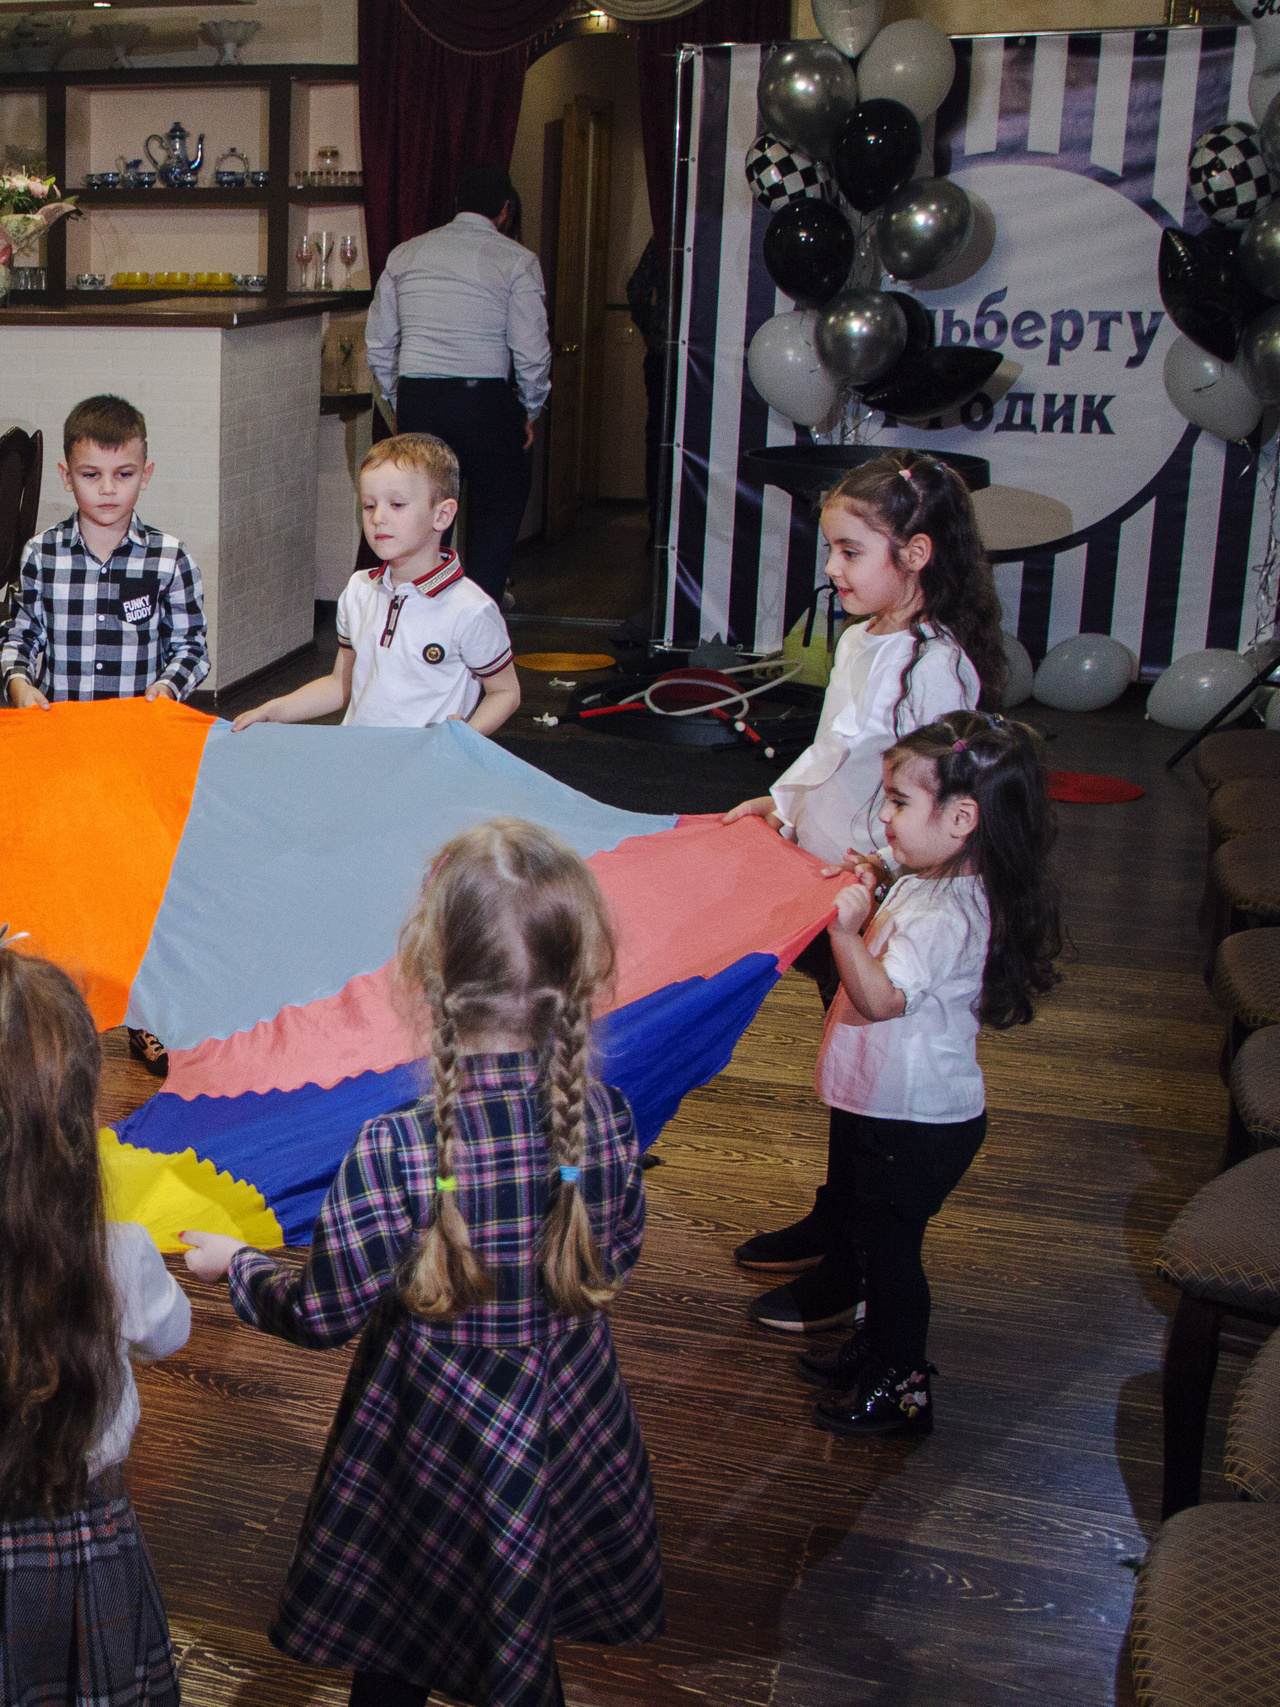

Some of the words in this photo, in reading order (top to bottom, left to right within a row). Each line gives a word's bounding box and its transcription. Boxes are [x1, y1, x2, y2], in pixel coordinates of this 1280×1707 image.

[924, 392, 1117, 435] одик
[122, 595, 150, 613] FUNKY
[125, 605, 152, 623] BUDDY
